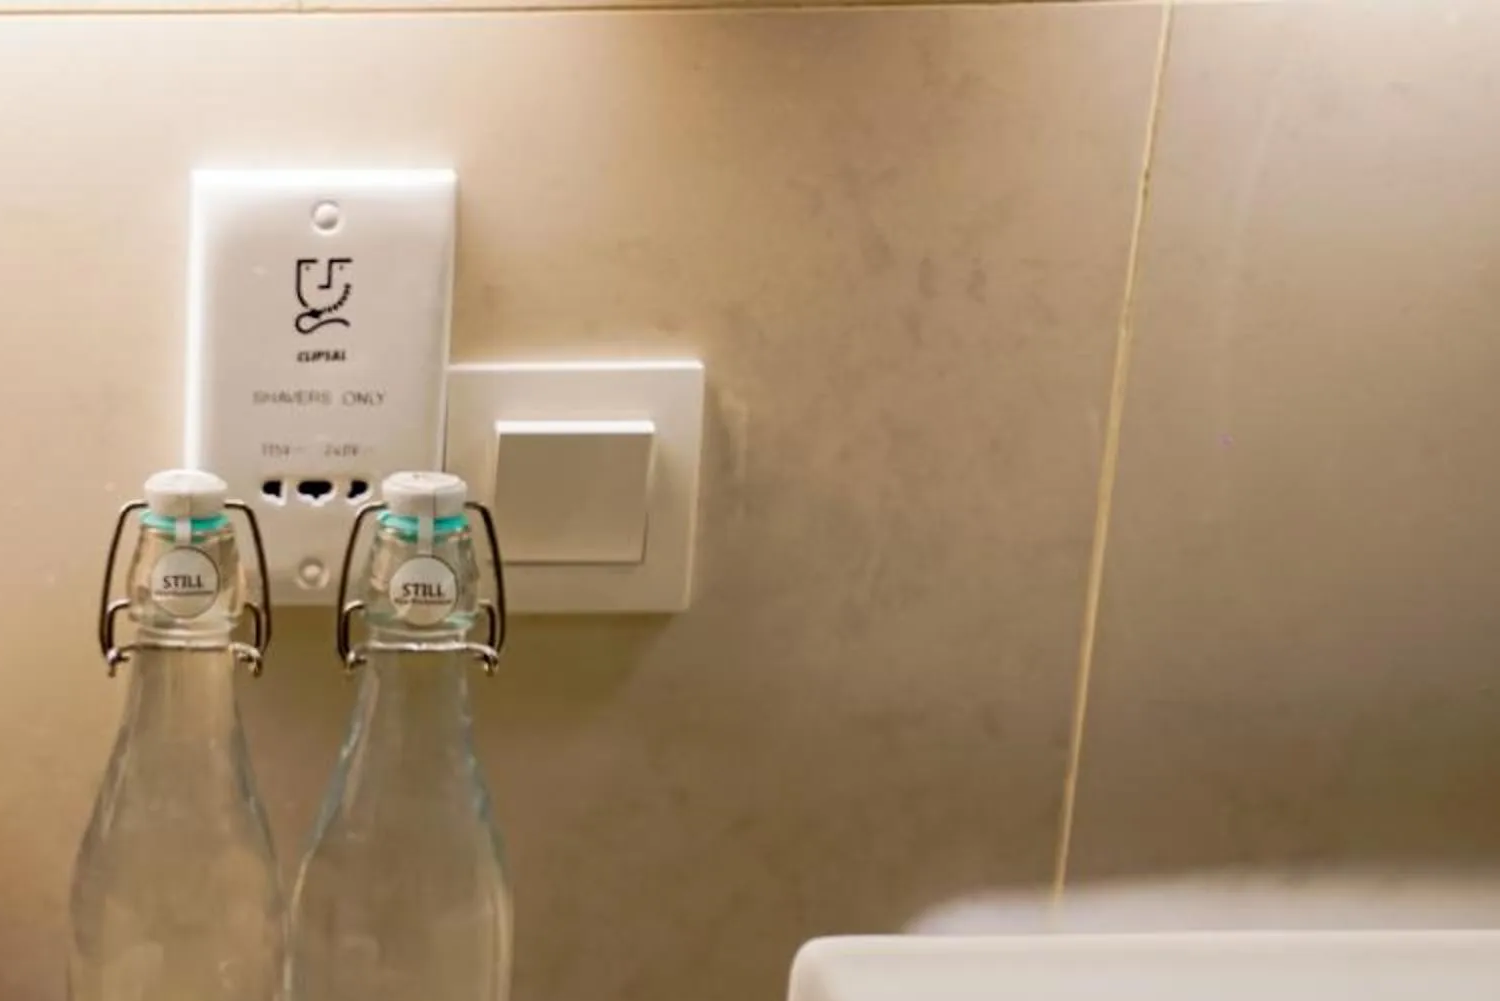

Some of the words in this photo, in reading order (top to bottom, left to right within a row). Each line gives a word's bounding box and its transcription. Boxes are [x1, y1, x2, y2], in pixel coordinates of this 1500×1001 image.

[252, 390, 332, 406] SHAVERS
[341, 390, 385, 406] ONLY
[162, 575, 205, 589] STILL
[401, 582, 446, 597] STILL
